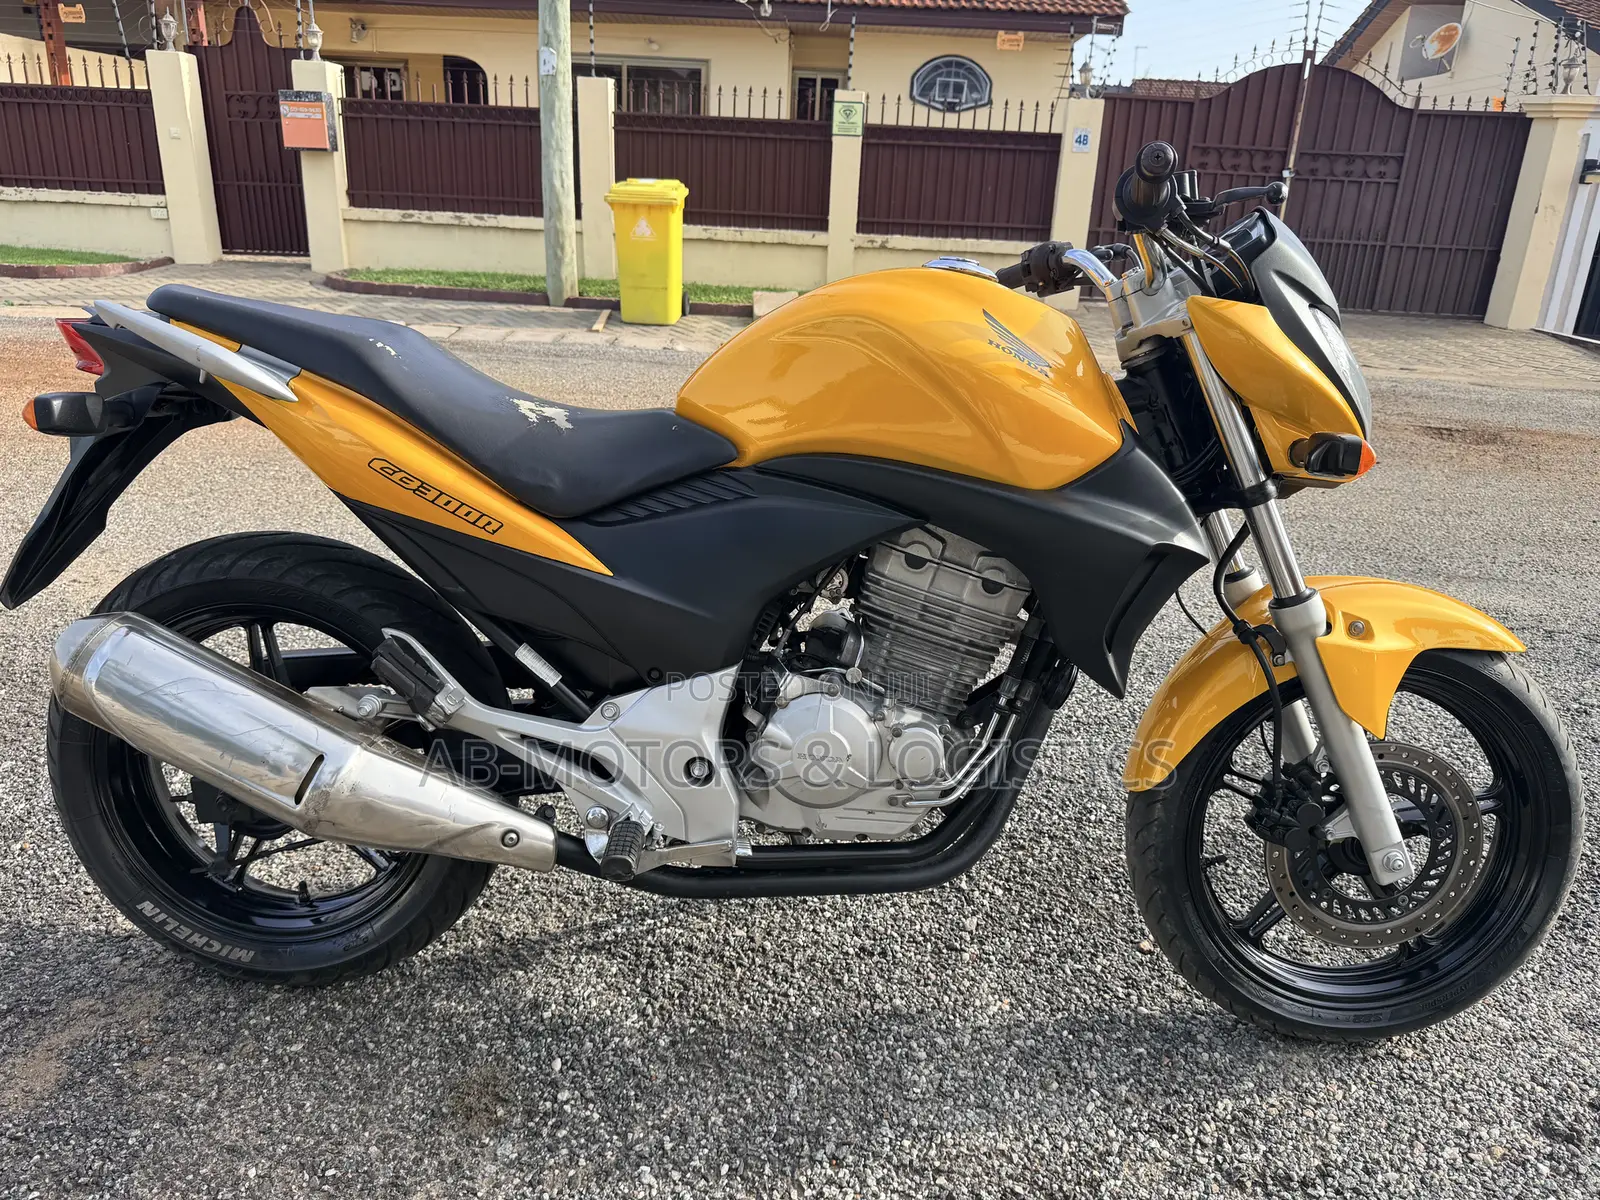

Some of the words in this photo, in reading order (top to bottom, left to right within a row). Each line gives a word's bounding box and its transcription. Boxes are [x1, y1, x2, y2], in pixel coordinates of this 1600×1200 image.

[1074, 134, 1089, 146] 48
[987, 339, 1050, 379] HONDA
[136, 900, 256, 963] MICHELIN
